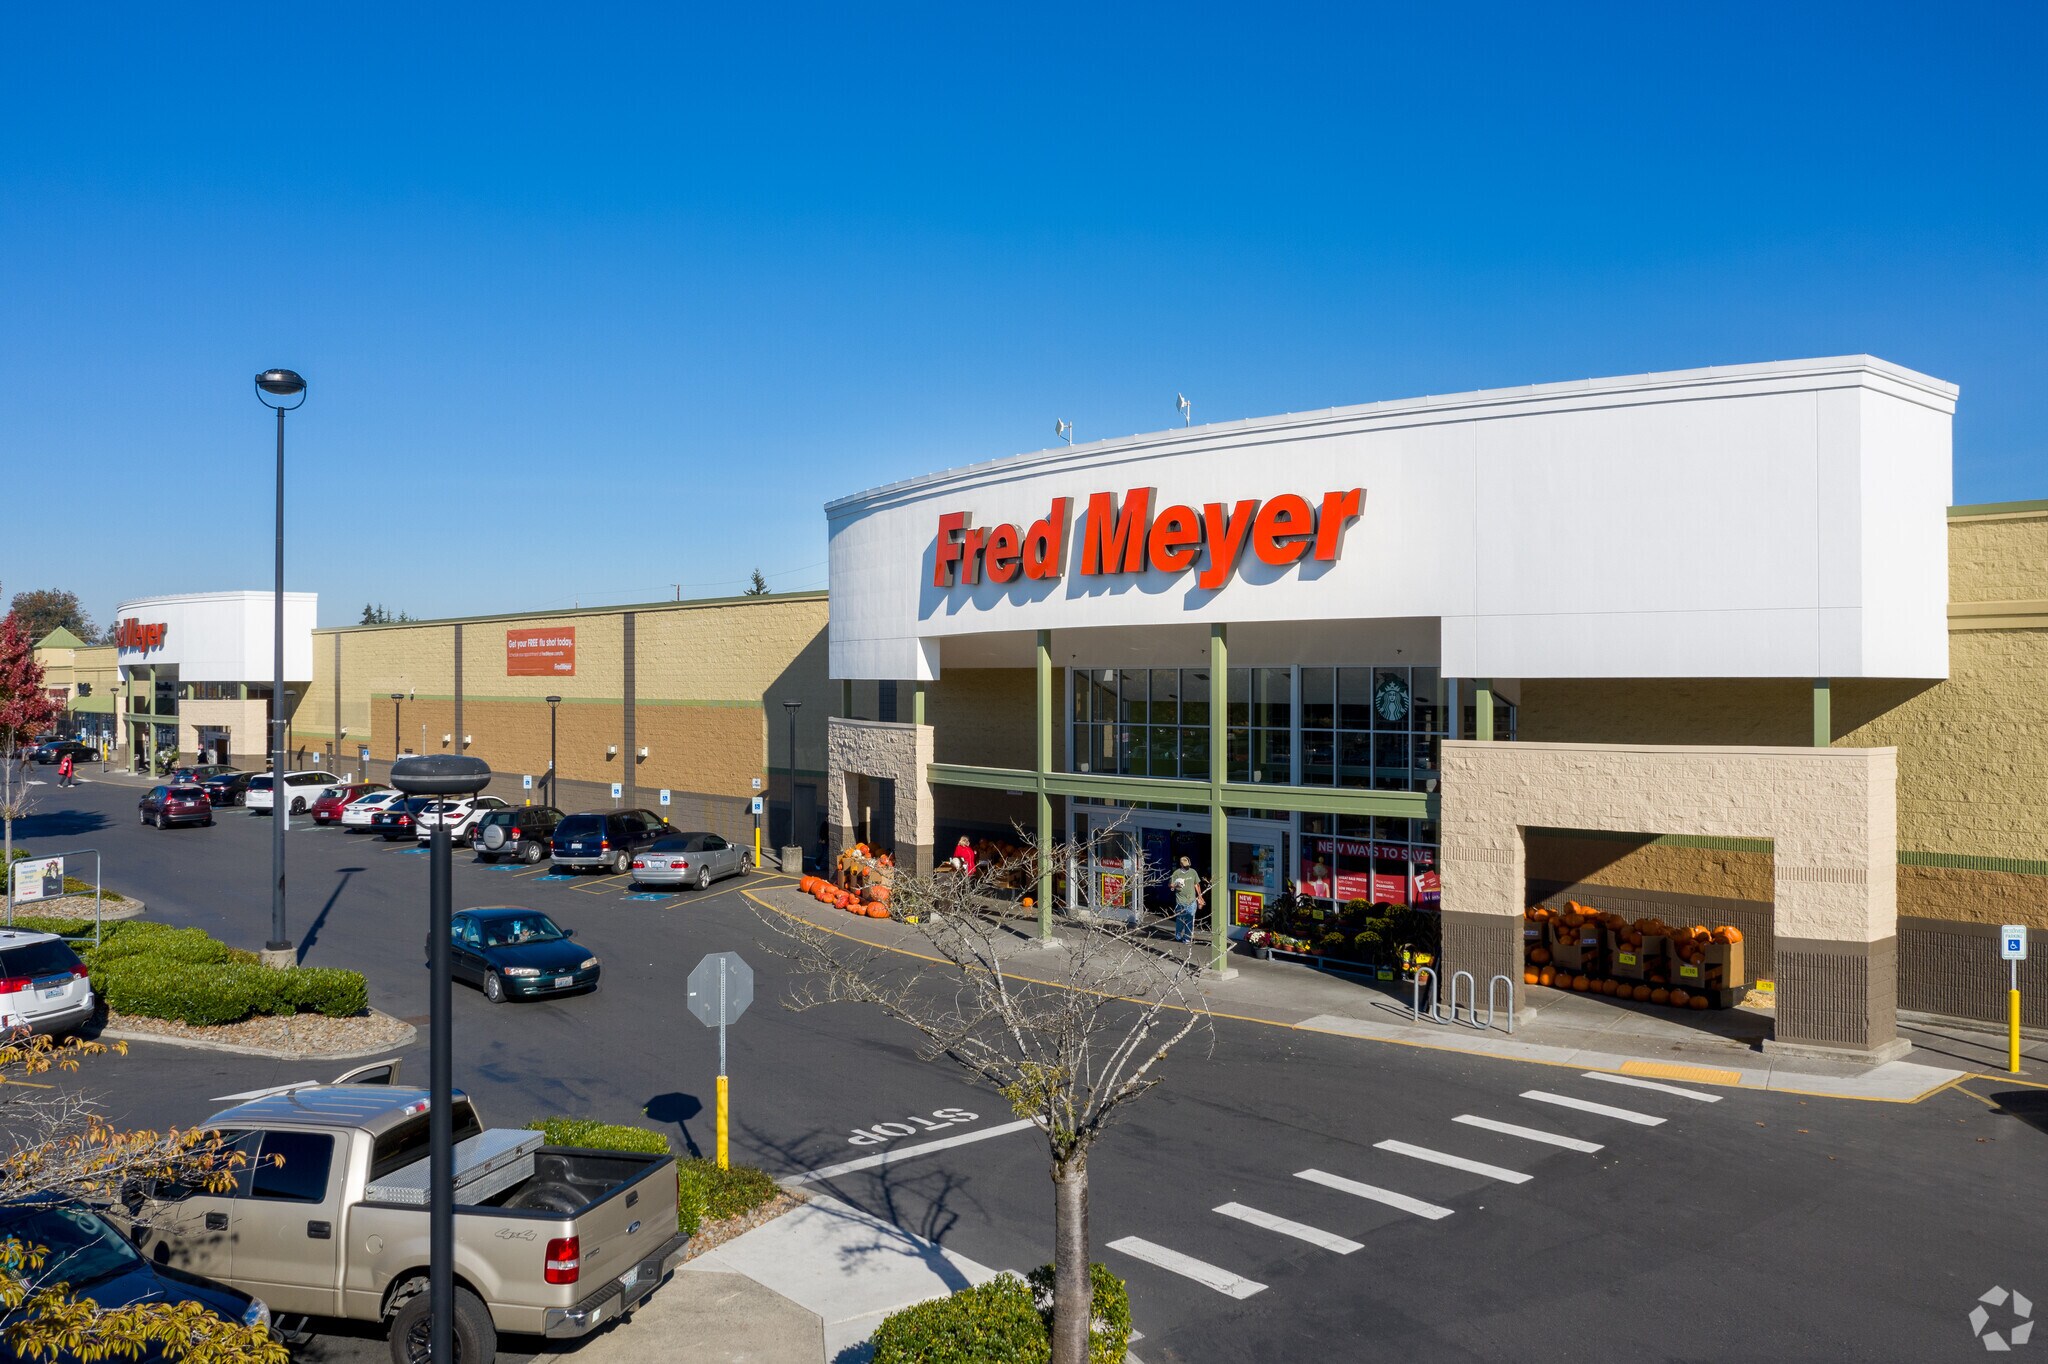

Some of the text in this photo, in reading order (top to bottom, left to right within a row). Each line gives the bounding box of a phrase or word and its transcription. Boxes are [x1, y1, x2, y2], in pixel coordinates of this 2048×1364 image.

[934, 486, 1367, 589] Fred Meyer
[528, 638, 538, 647] FREE
[1318, 841, 1432, 863] NEW WAYS TO SAVE
[848, 1108, 979, 1145] STOP
[495, 1228, 537, 1241] 4x4
